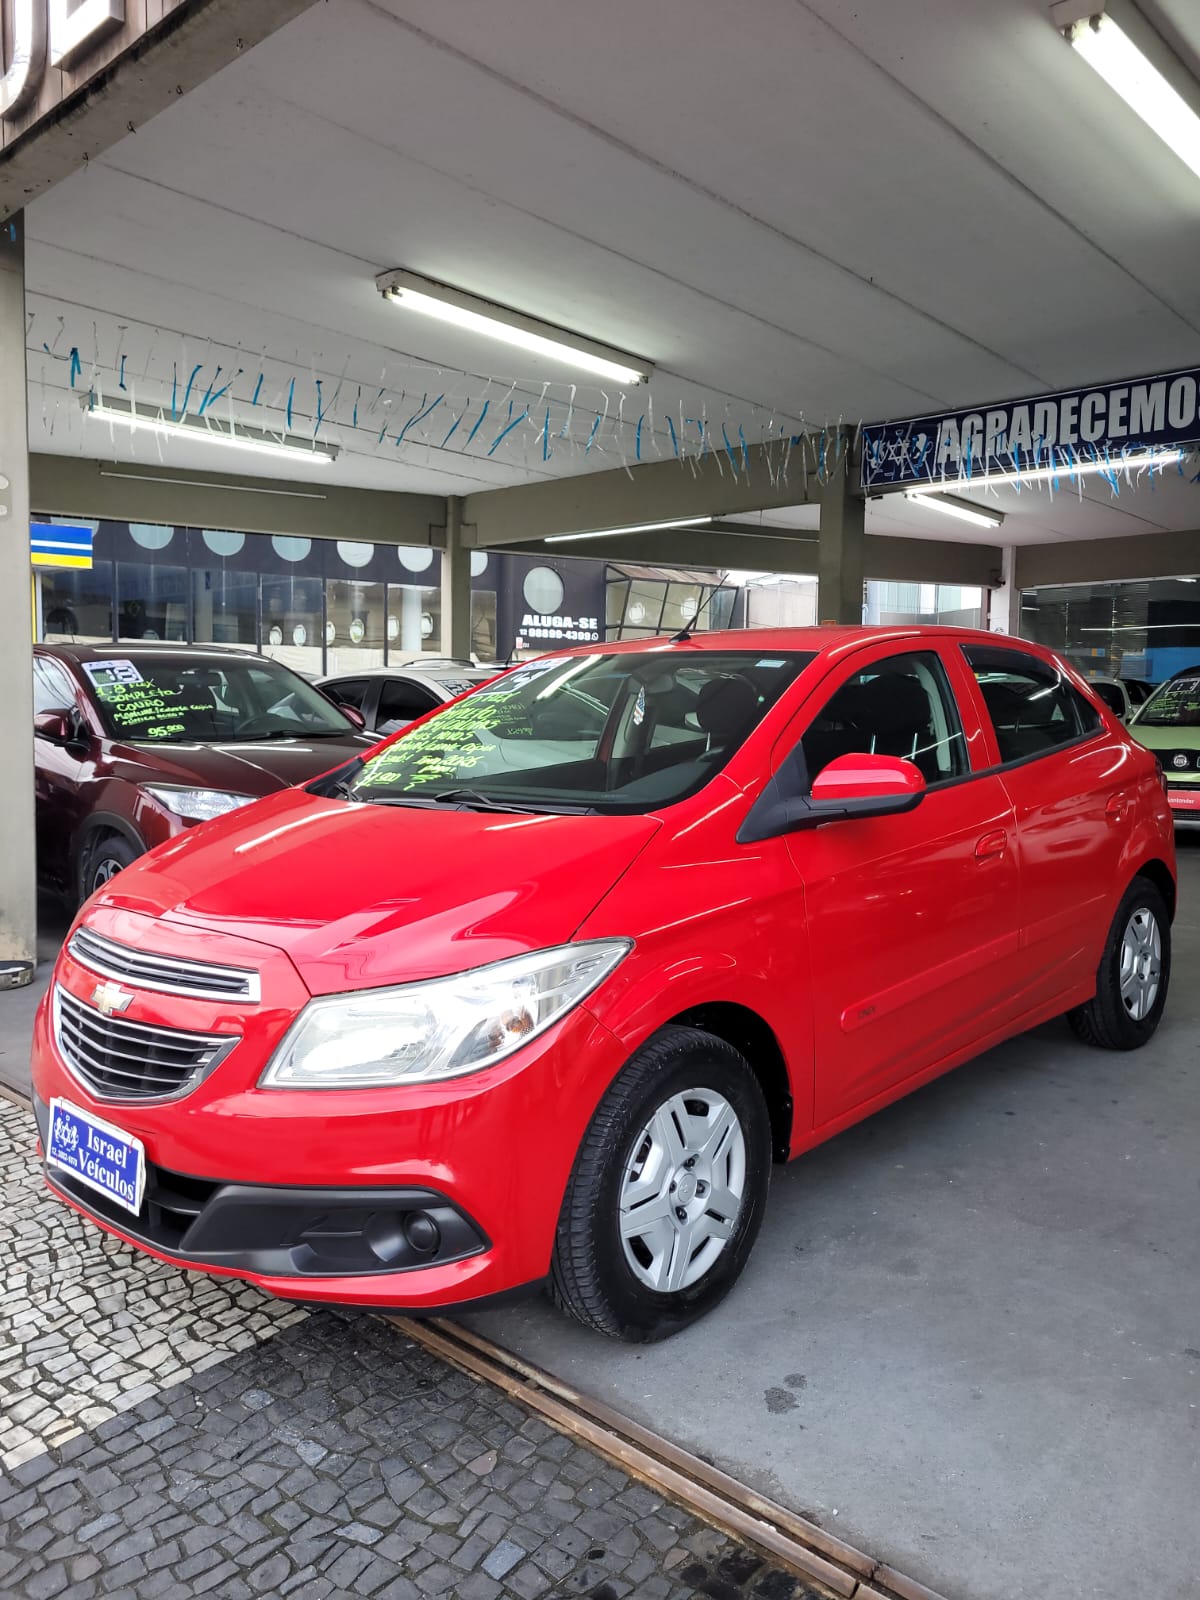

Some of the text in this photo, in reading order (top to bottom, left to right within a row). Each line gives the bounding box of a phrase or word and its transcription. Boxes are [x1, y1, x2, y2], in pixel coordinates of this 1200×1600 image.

[936, 376, 1200, 462] AGRADECEMO
[522, 614, 598, 629] ALUGA-SE
[116, 699, 165, 712] COURO
[87, 1126, 128, 1169] Israel
[78, 1147, 135, 1202] Veículos
